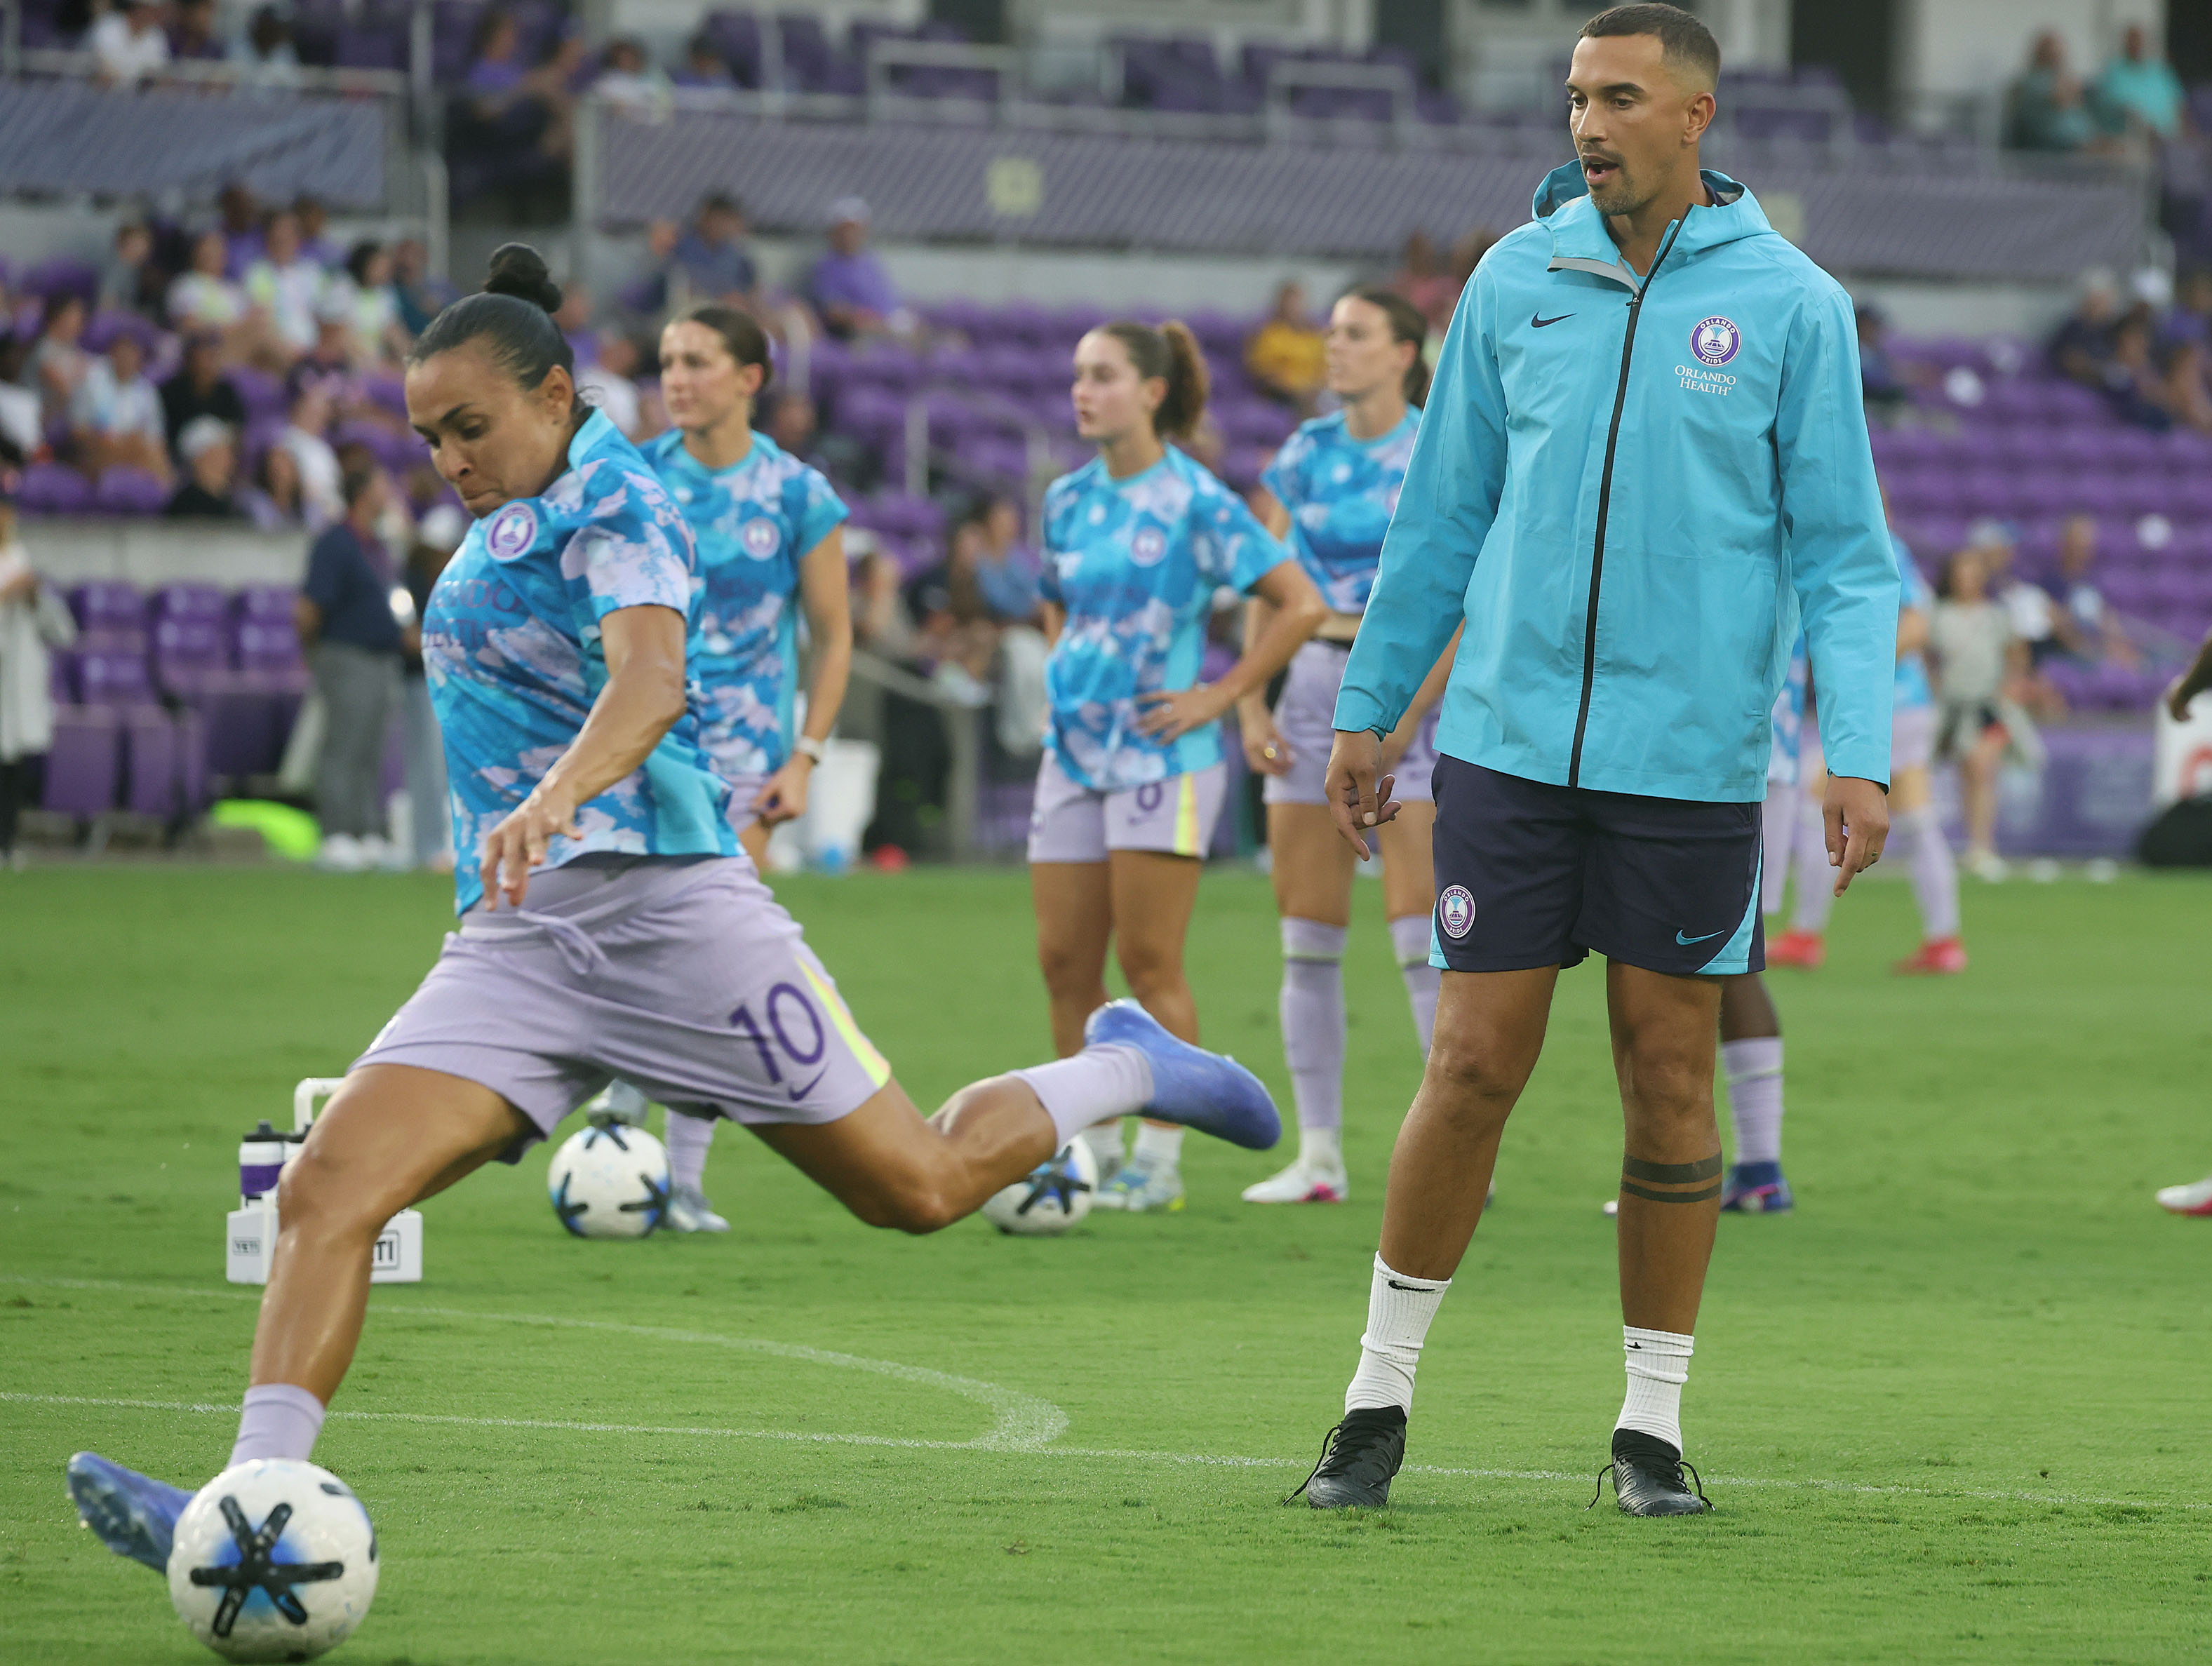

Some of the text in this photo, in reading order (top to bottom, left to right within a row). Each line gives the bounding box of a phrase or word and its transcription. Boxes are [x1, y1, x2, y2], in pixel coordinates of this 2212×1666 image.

[1700, 318, 1736, 334] ORLANDO
[1701, 355, 1722, 364] PRIDE
[1675, 365, 1737, 385] ORLANDO
[1444, 890, 1469, 902] ORLANDO
[728, 982, 825, 1084] 10
